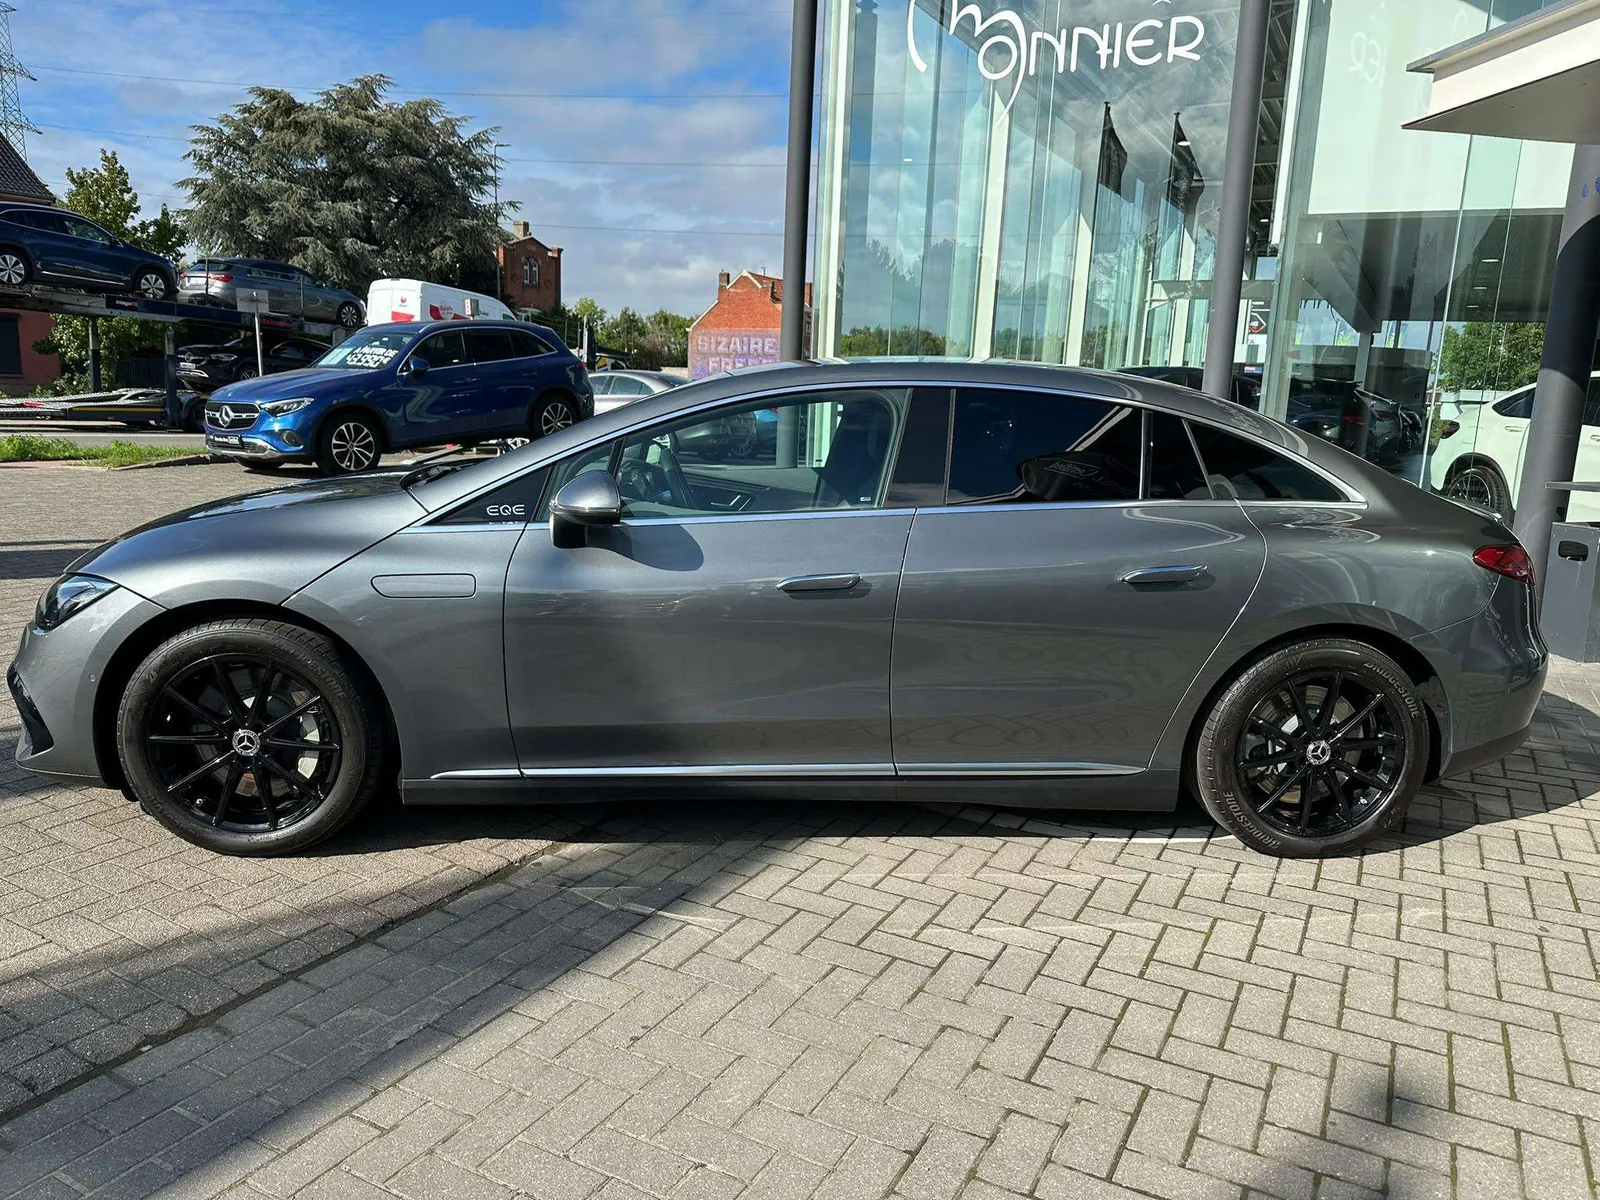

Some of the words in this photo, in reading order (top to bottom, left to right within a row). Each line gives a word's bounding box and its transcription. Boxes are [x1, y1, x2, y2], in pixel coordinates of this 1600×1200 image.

[486, 504, 526, 516] EQE
[1363, 661, 1421, 718] BRIDGESTONE
[1222, 790, 1283, 850] BRIDGESTONE
